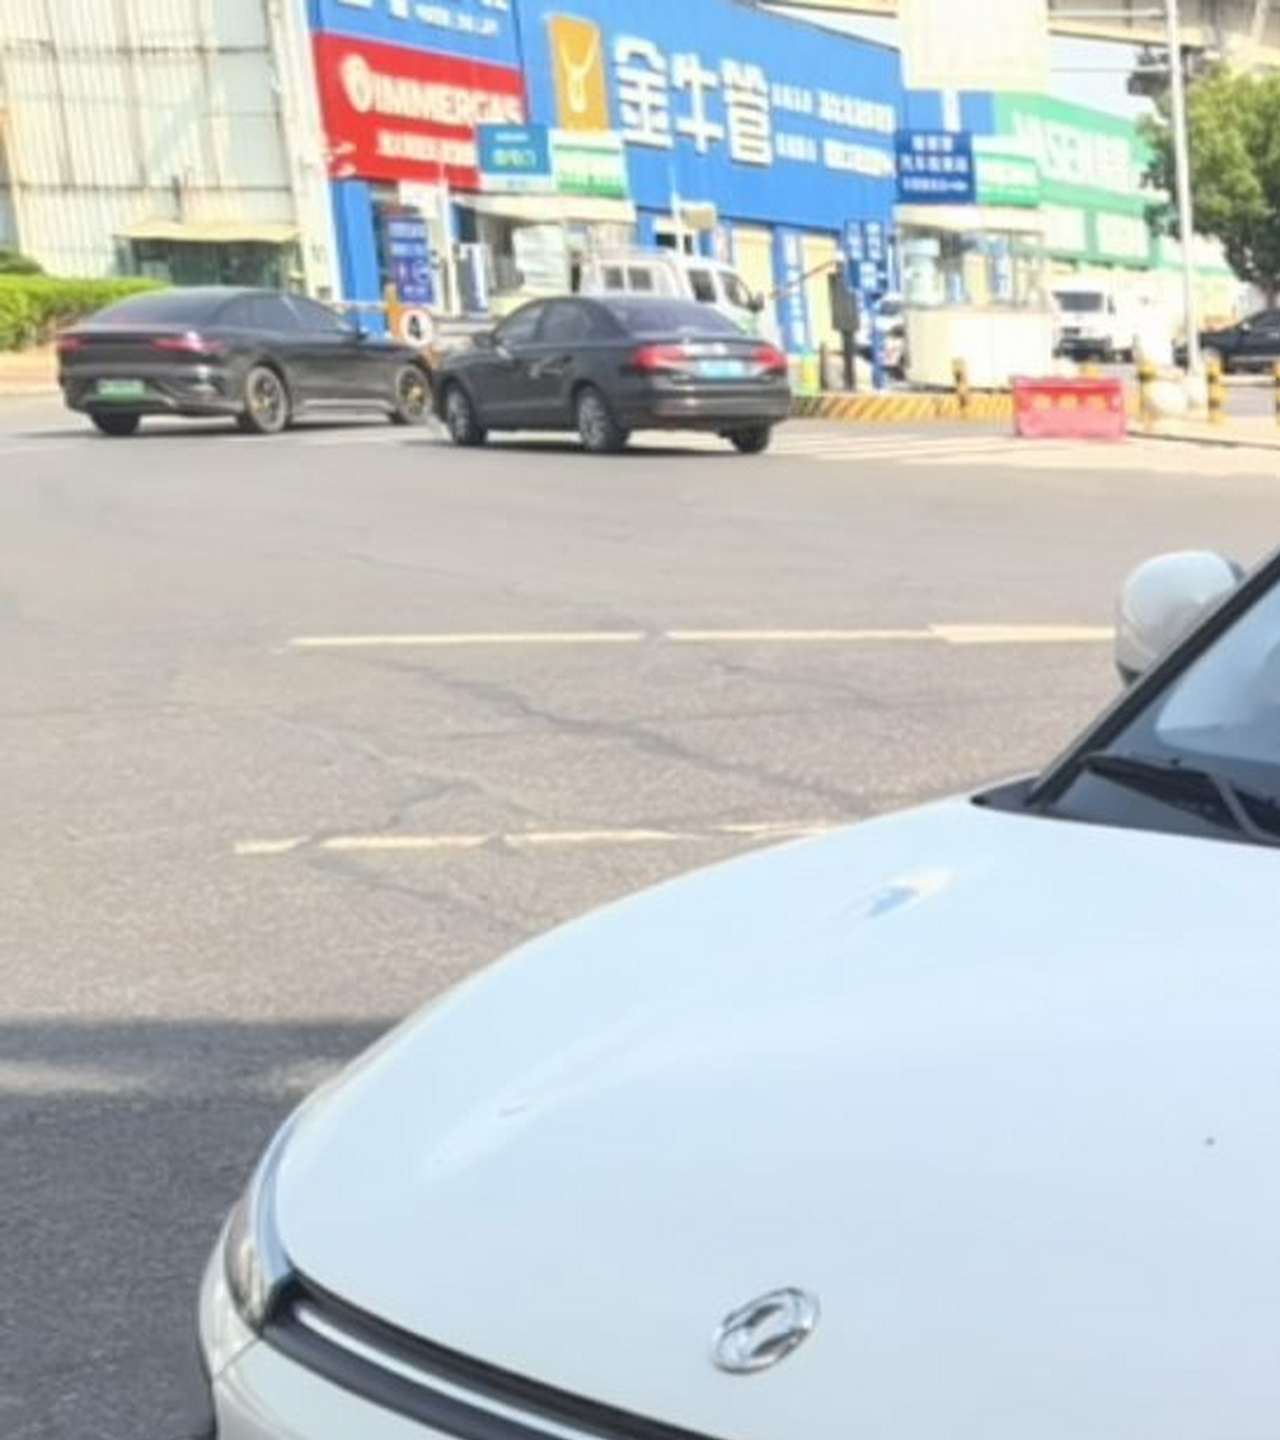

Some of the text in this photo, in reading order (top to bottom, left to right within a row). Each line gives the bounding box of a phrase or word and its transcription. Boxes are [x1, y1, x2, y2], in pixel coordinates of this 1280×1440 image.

[370, 70, 525, 127] IMMERGAS
[613, 34, 774, 167] 金牛管
